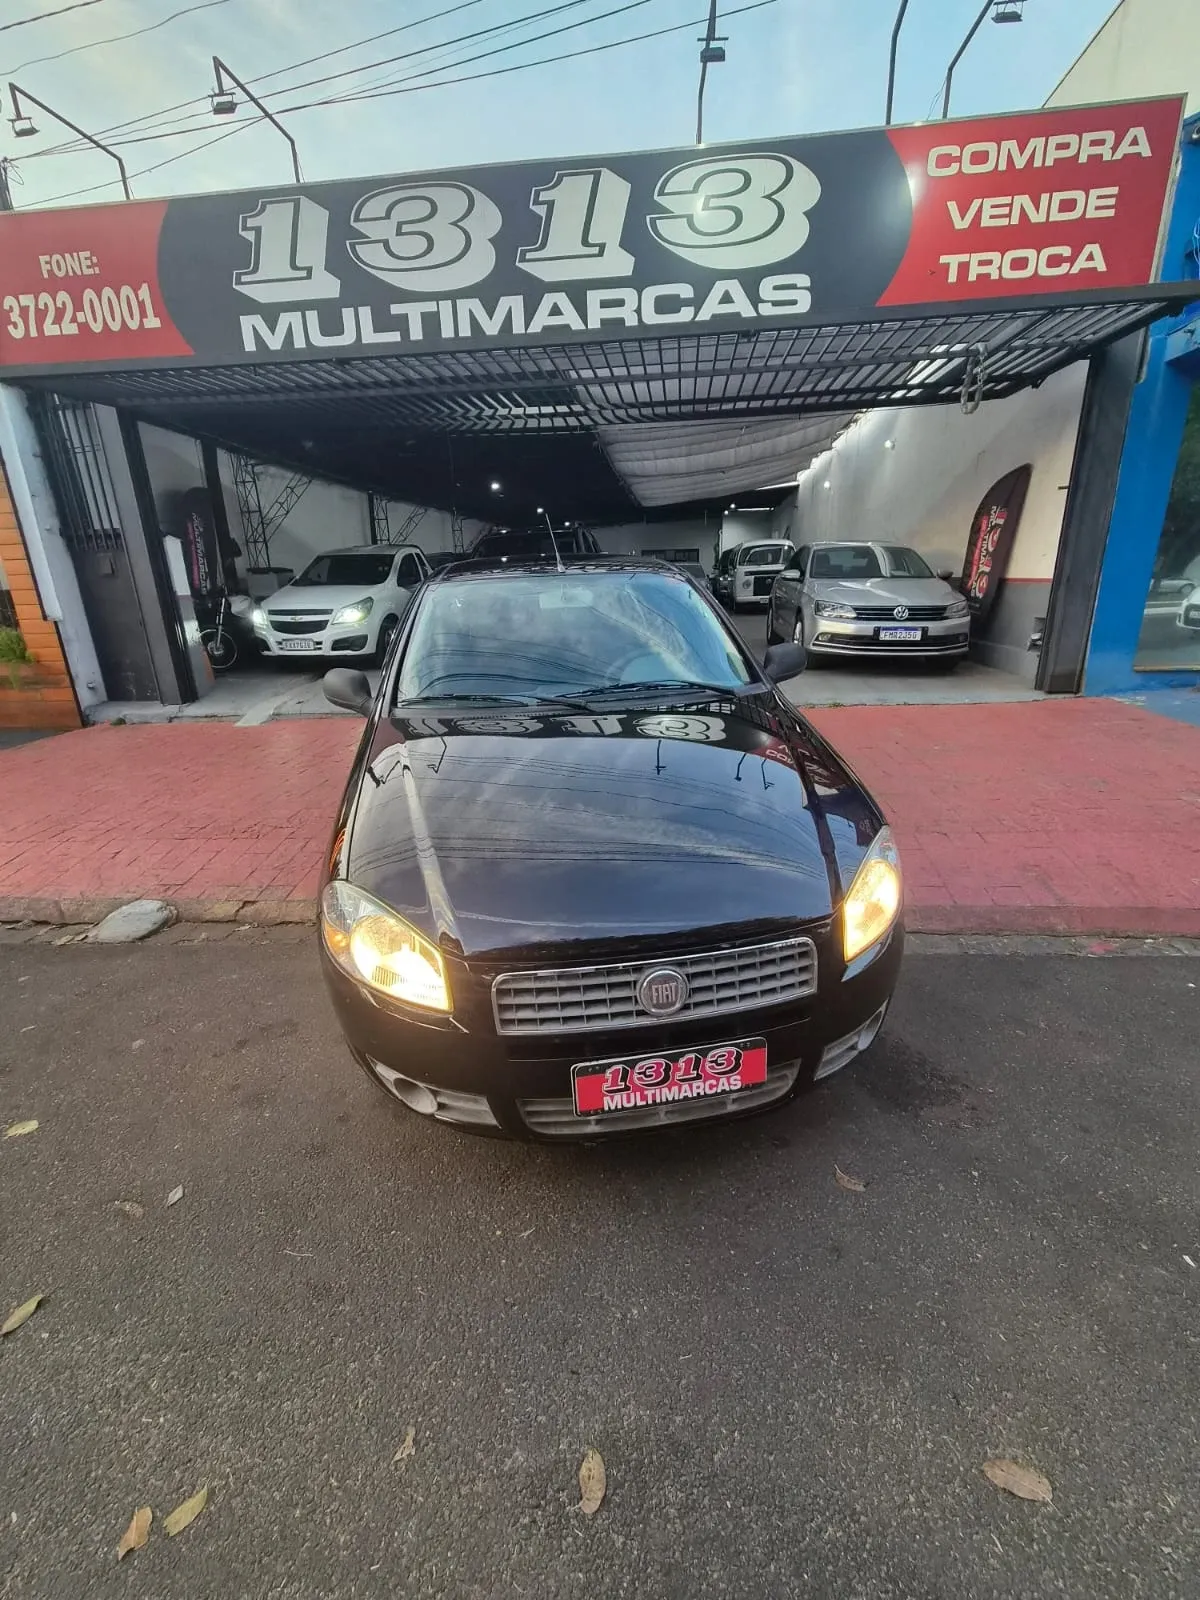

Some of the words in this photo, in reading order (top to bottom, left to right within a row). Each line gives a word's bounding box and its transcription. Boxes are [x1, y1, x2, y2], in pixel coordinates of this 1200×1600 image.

[927, 126, 1152, 177] COMPRA
[232, 152, 822, 303] 1313
[946, 186, 1119, 230] VENDE
[38, 250, 101, 279] FONE:
[938, 243, 1107, 283] TROCA
[3, 282, 162, 339] 3722-0001
[239, 273, 812, 352] MULTIMARCAS
[970, 505, 997, 597] MUTIMARAS
[651, 982, 677, 1004] FIAT
[602, 1046, 743, 1096] 1313
[603, 1074, 742, 1111] MULTIMARCAS
